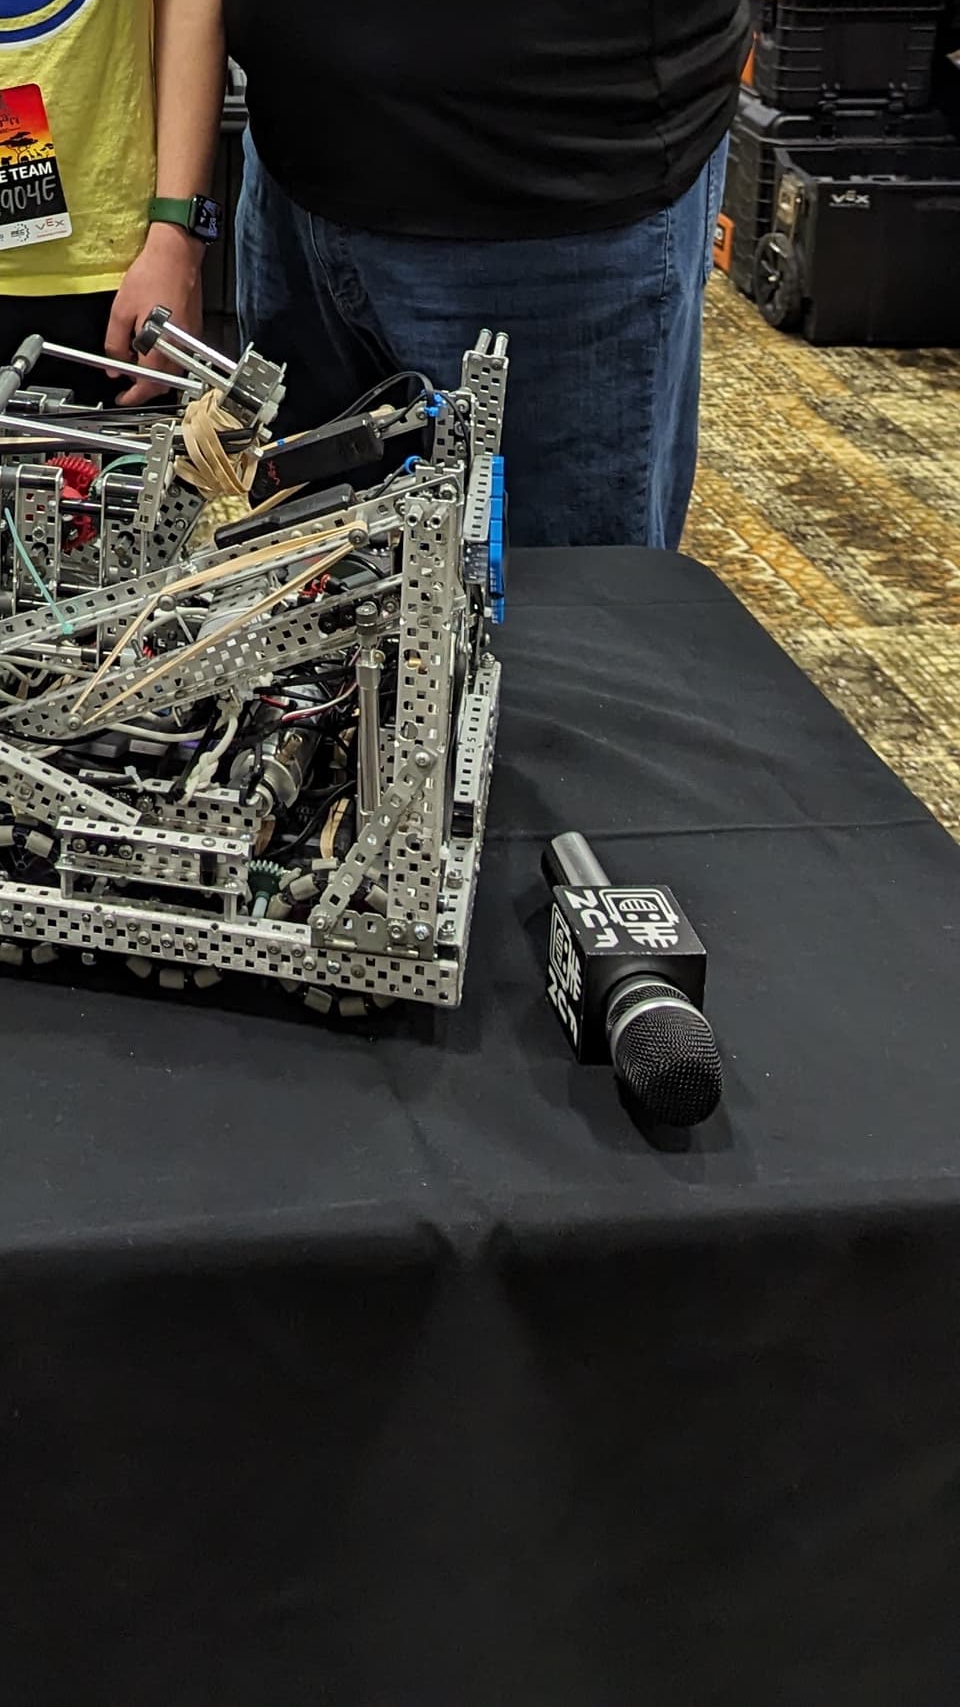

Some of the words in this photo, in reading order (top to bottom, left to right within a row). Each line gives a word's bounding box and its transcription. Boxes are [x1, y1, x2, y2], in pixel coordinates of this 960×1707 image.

[8, 161, 52, 181] TEAM
[563, 889, 620, 949] FUN
[546, 965, 578, 1047] FUN
